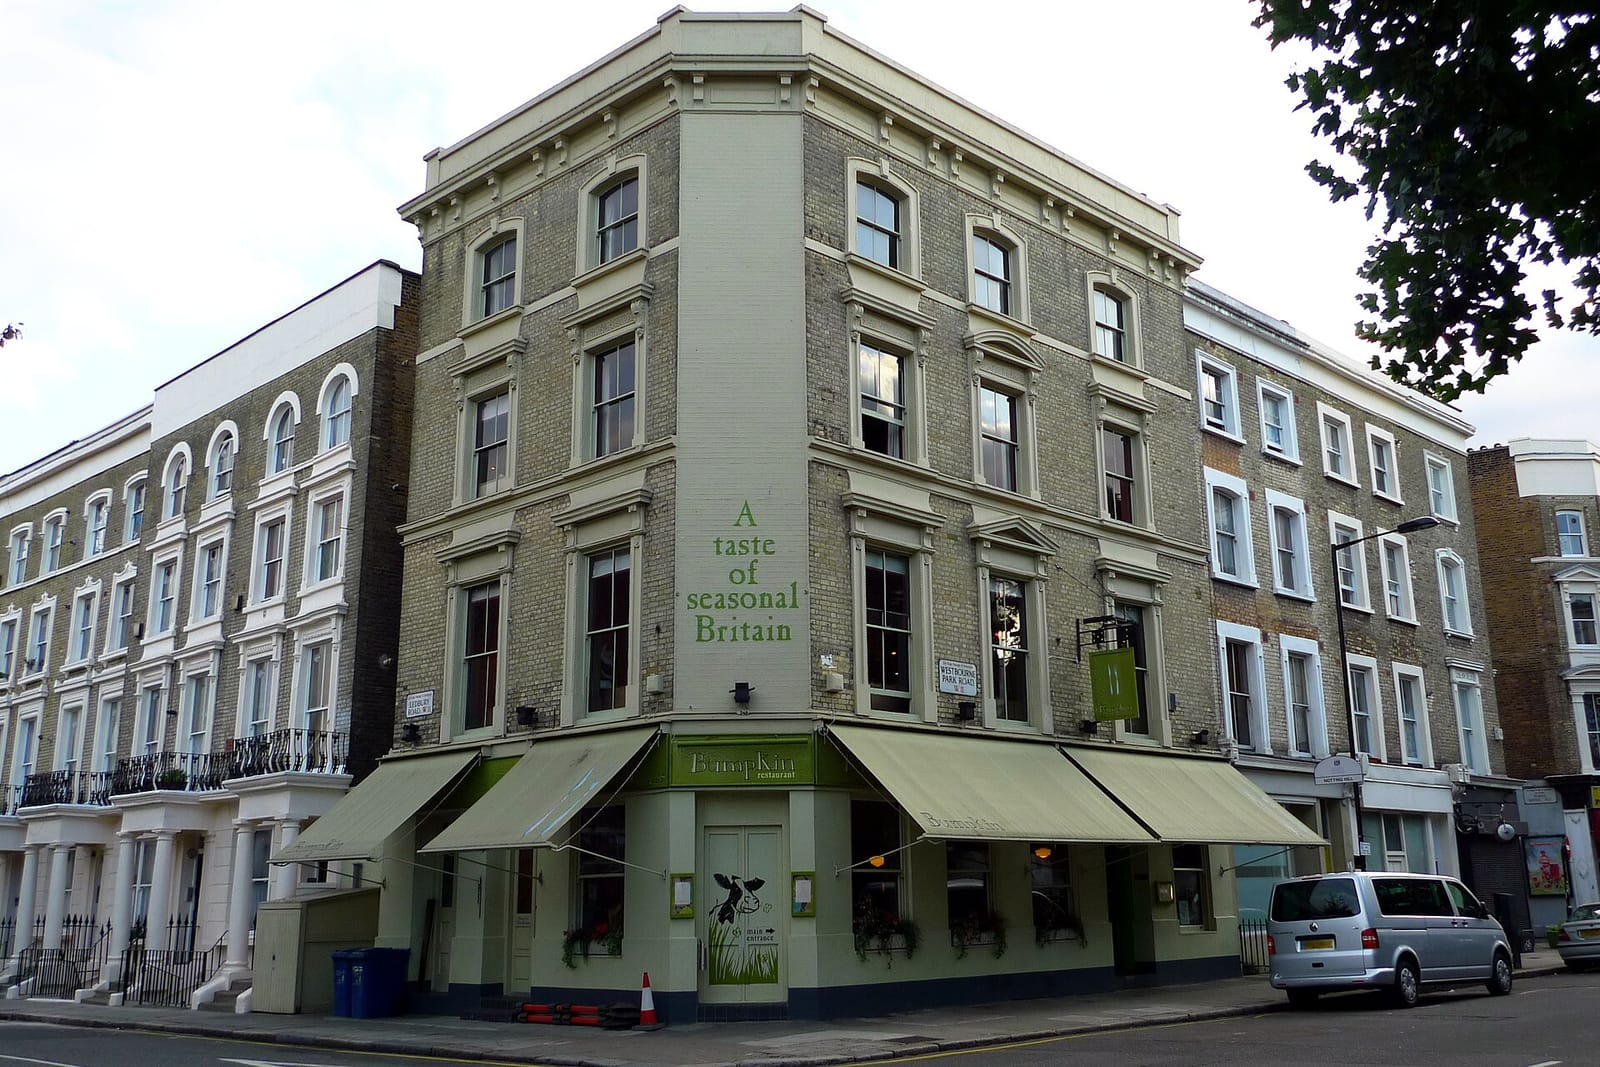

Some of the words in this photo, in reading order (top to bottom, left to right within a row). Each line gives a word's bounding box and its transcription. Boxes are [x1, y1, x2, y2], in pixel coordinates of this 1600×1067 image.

[733, 500, 757, 527] A
[713, 536, 775, 556] taste
[729, 559, 758, 585] of
[687, 581, 799, 610] seasonal
[695, 615, 792, 642] Britain
[941, 666, 976, 679] WESTBOURNE
[942, 675, 958, 684] PARK
[958, 677, 975, 687] ROAD
[757, 771, 795, 779] restaurant
